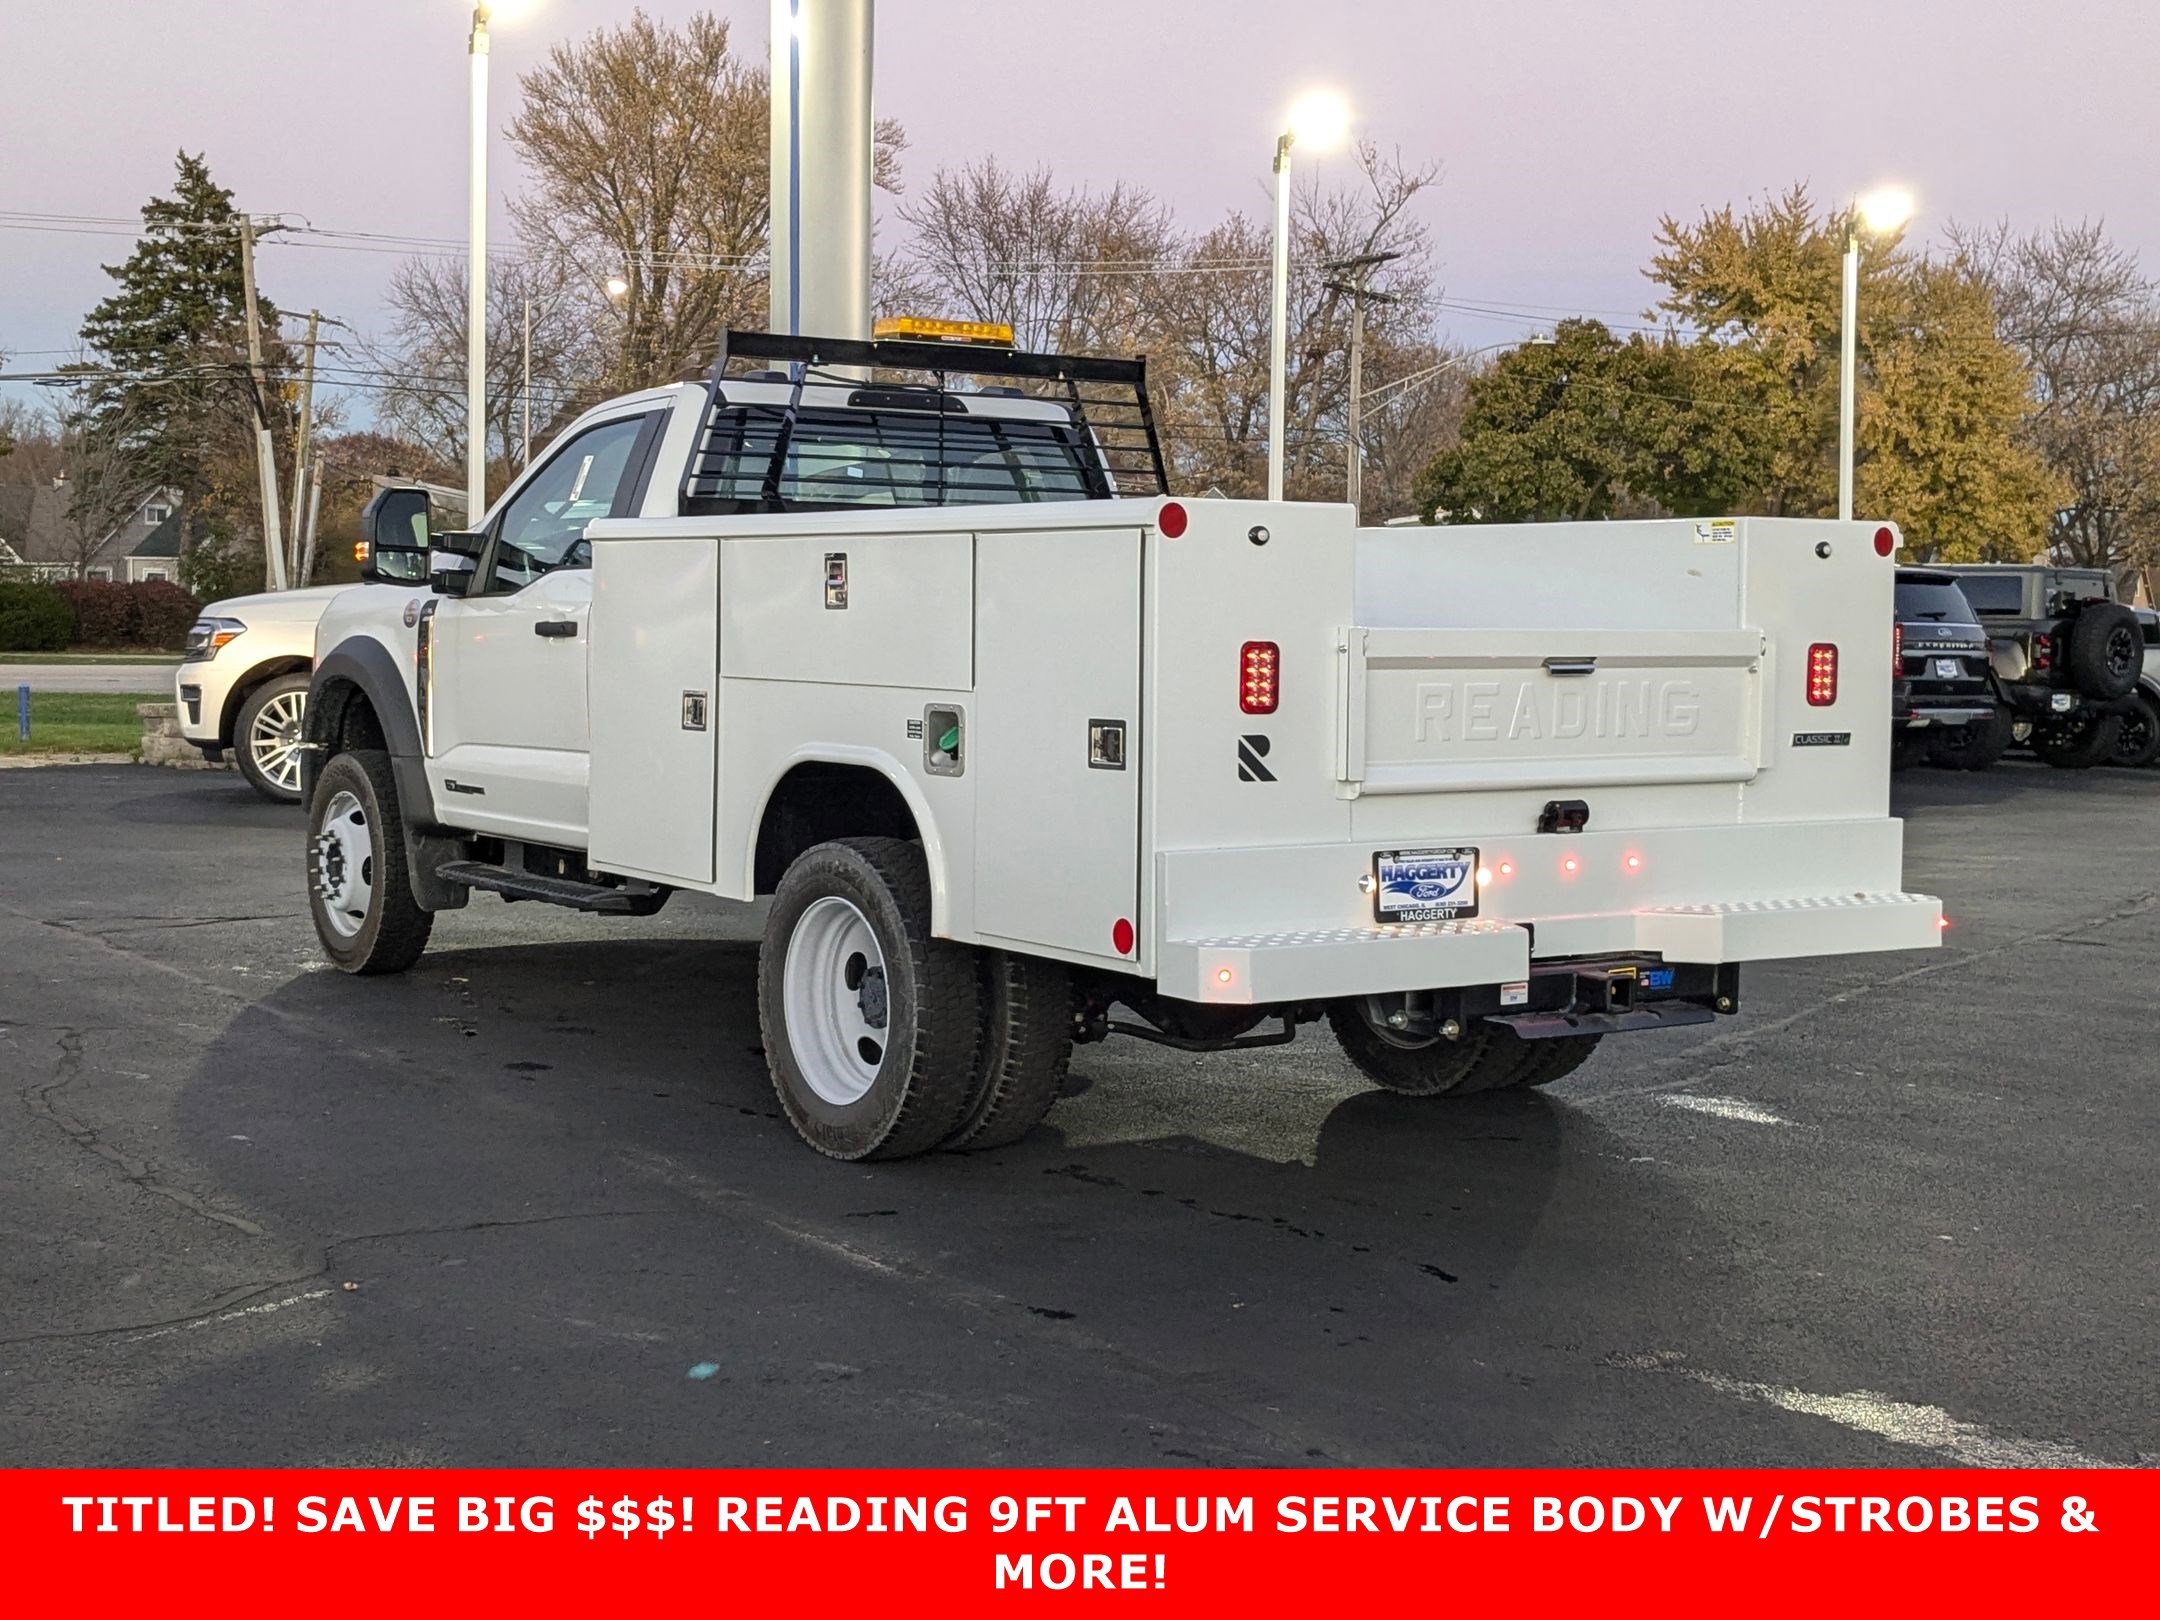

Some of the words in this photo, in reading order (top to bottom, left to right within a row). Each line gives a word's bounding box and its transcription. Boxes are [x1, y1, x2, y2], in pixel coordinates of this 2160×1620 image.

[1414, 680, 1701, 742] READING
[1794, 734, 1833, 745] CLASSIC
[1380, 862, 1471, 883] HAGGERTY
[1416, 884, 1440, 898] Ford
[1400, 908, 1457, 921] HAGGERTY
